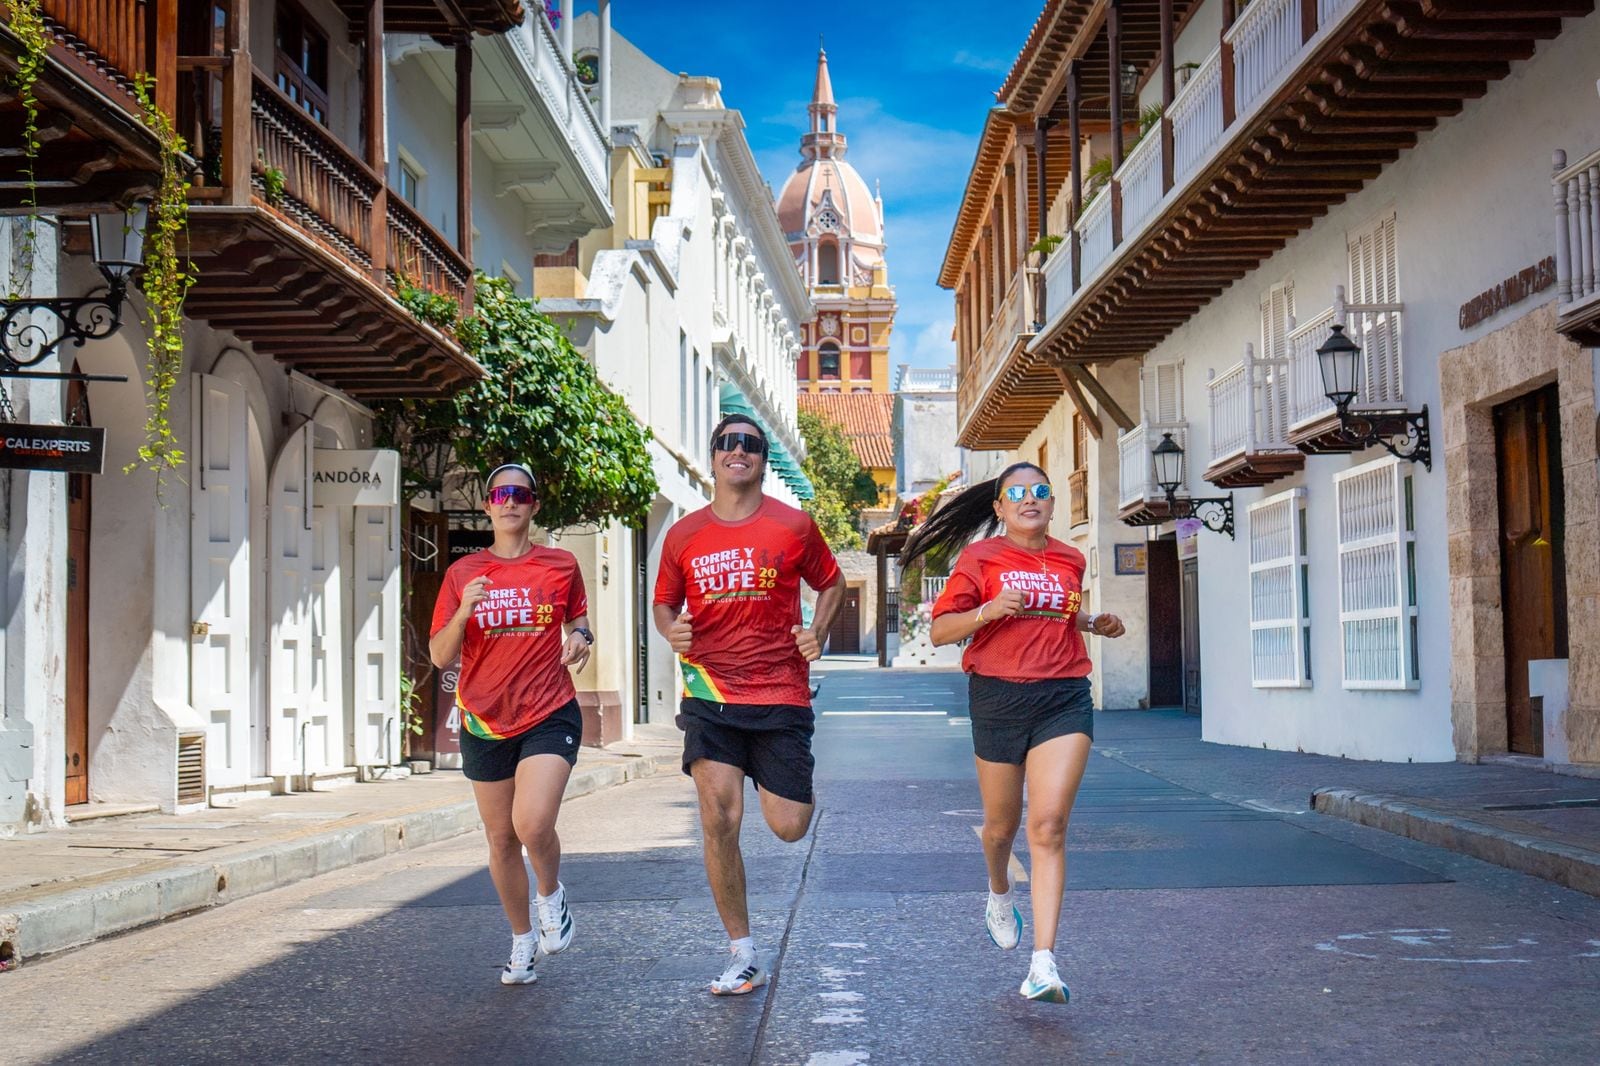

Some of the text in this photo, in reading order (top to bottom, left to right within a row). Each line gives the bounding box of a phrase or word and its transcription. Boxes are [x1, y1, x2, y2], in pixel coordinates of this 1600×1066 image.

[32, 439, 90, 452] EXPERTS
[313, 467, 382, 483] ANDORA
[691, 547, 755, 568] CORRE Y
[694, 558, 755, 578] ANUNCIA
[758, 567, 778, 578] 20
[1000, 570, 1059, 582] CORRE Y
[694, 571, 756, 594] TU FE
[758, 579, 776, 588] 26
[1002, 580, 1064, 592] ANUNCIA
[487, 588, 531, 599] RRE Y
[1067, 591, 1081, 602] 20
[474, 597, 532, 612] ANUNCIA
[1036, 592, 1065, 610] FE
[536, 604, 554, 614] 20
[1065, 602, 1079, 613] 26
[475, 608, 534, 628] TU FE
[536, 614, 553, 624] 26
